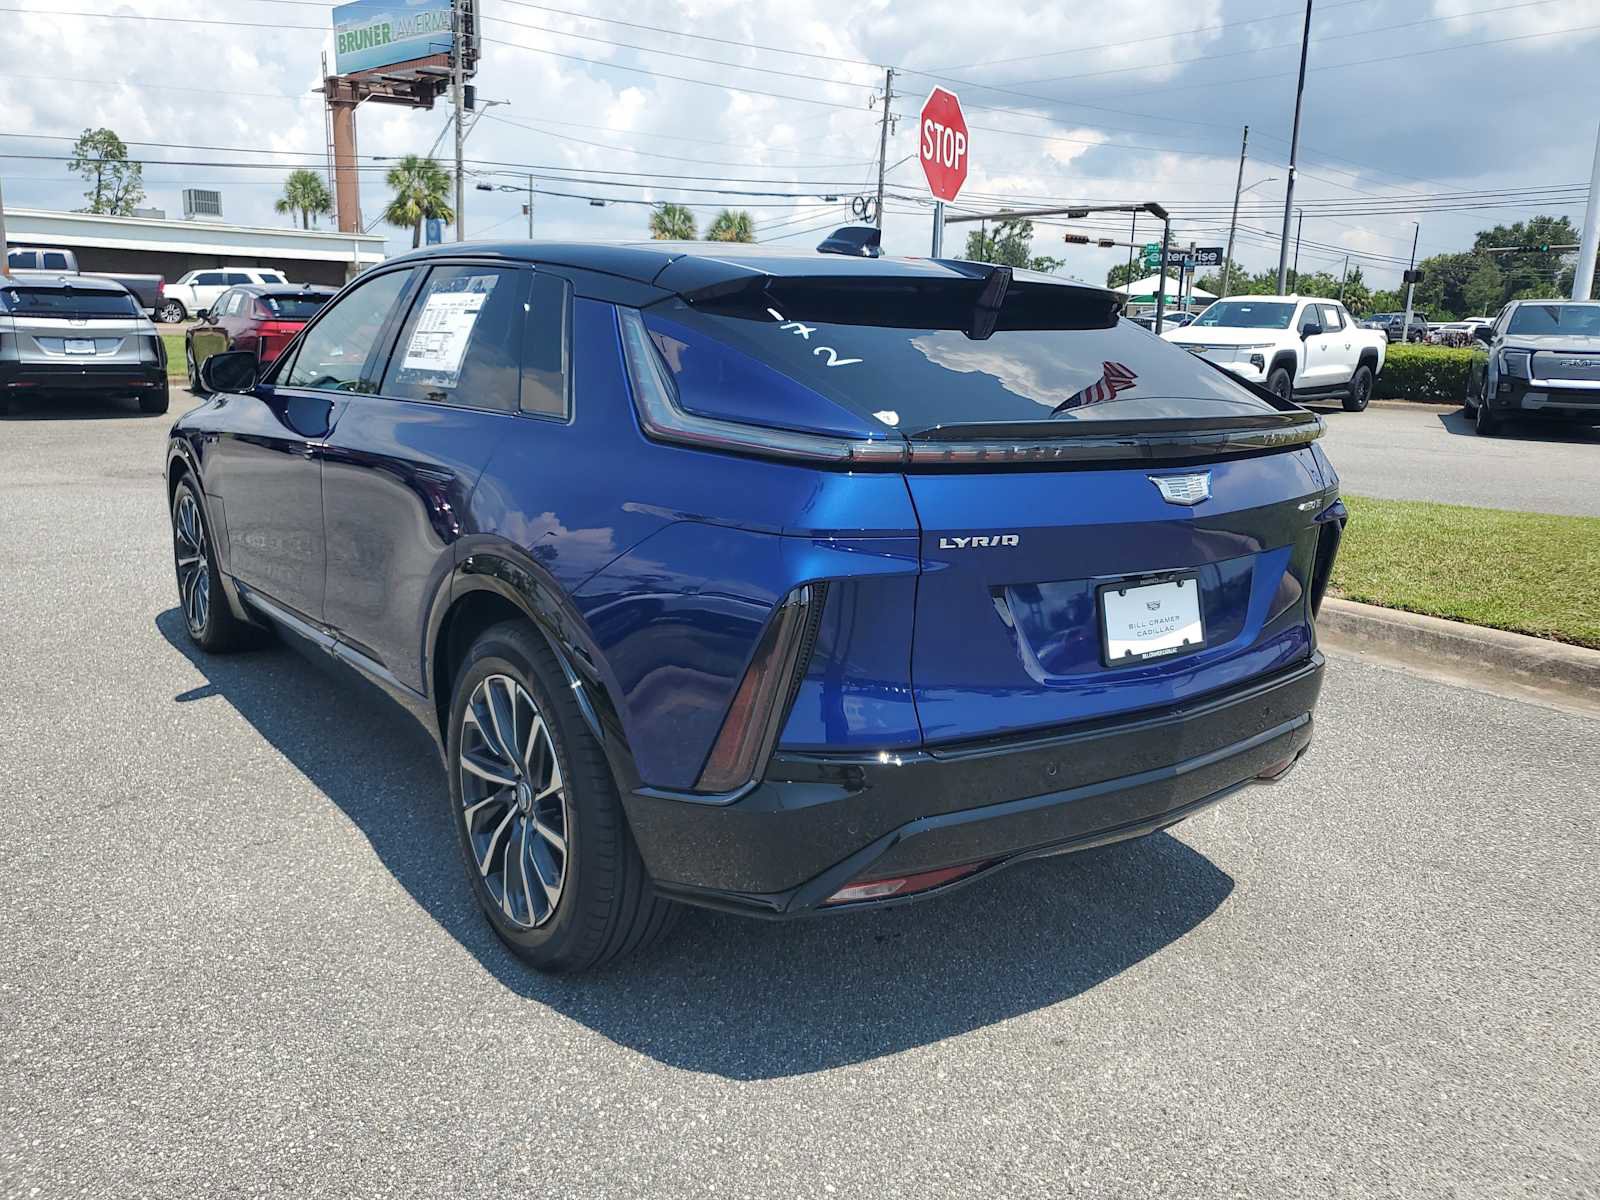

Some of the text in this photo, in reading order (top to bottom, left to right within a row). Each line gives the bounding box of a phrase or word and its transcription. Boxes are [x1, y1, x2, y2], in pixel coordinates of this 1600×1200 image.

[338, 22, 391, 54] BRUNER
[922, 118, 966, 171] STOP
[1128, 615, 1180, 631] BILL CRAMER
[1136, 625, 1175, 637] CADILLAC
